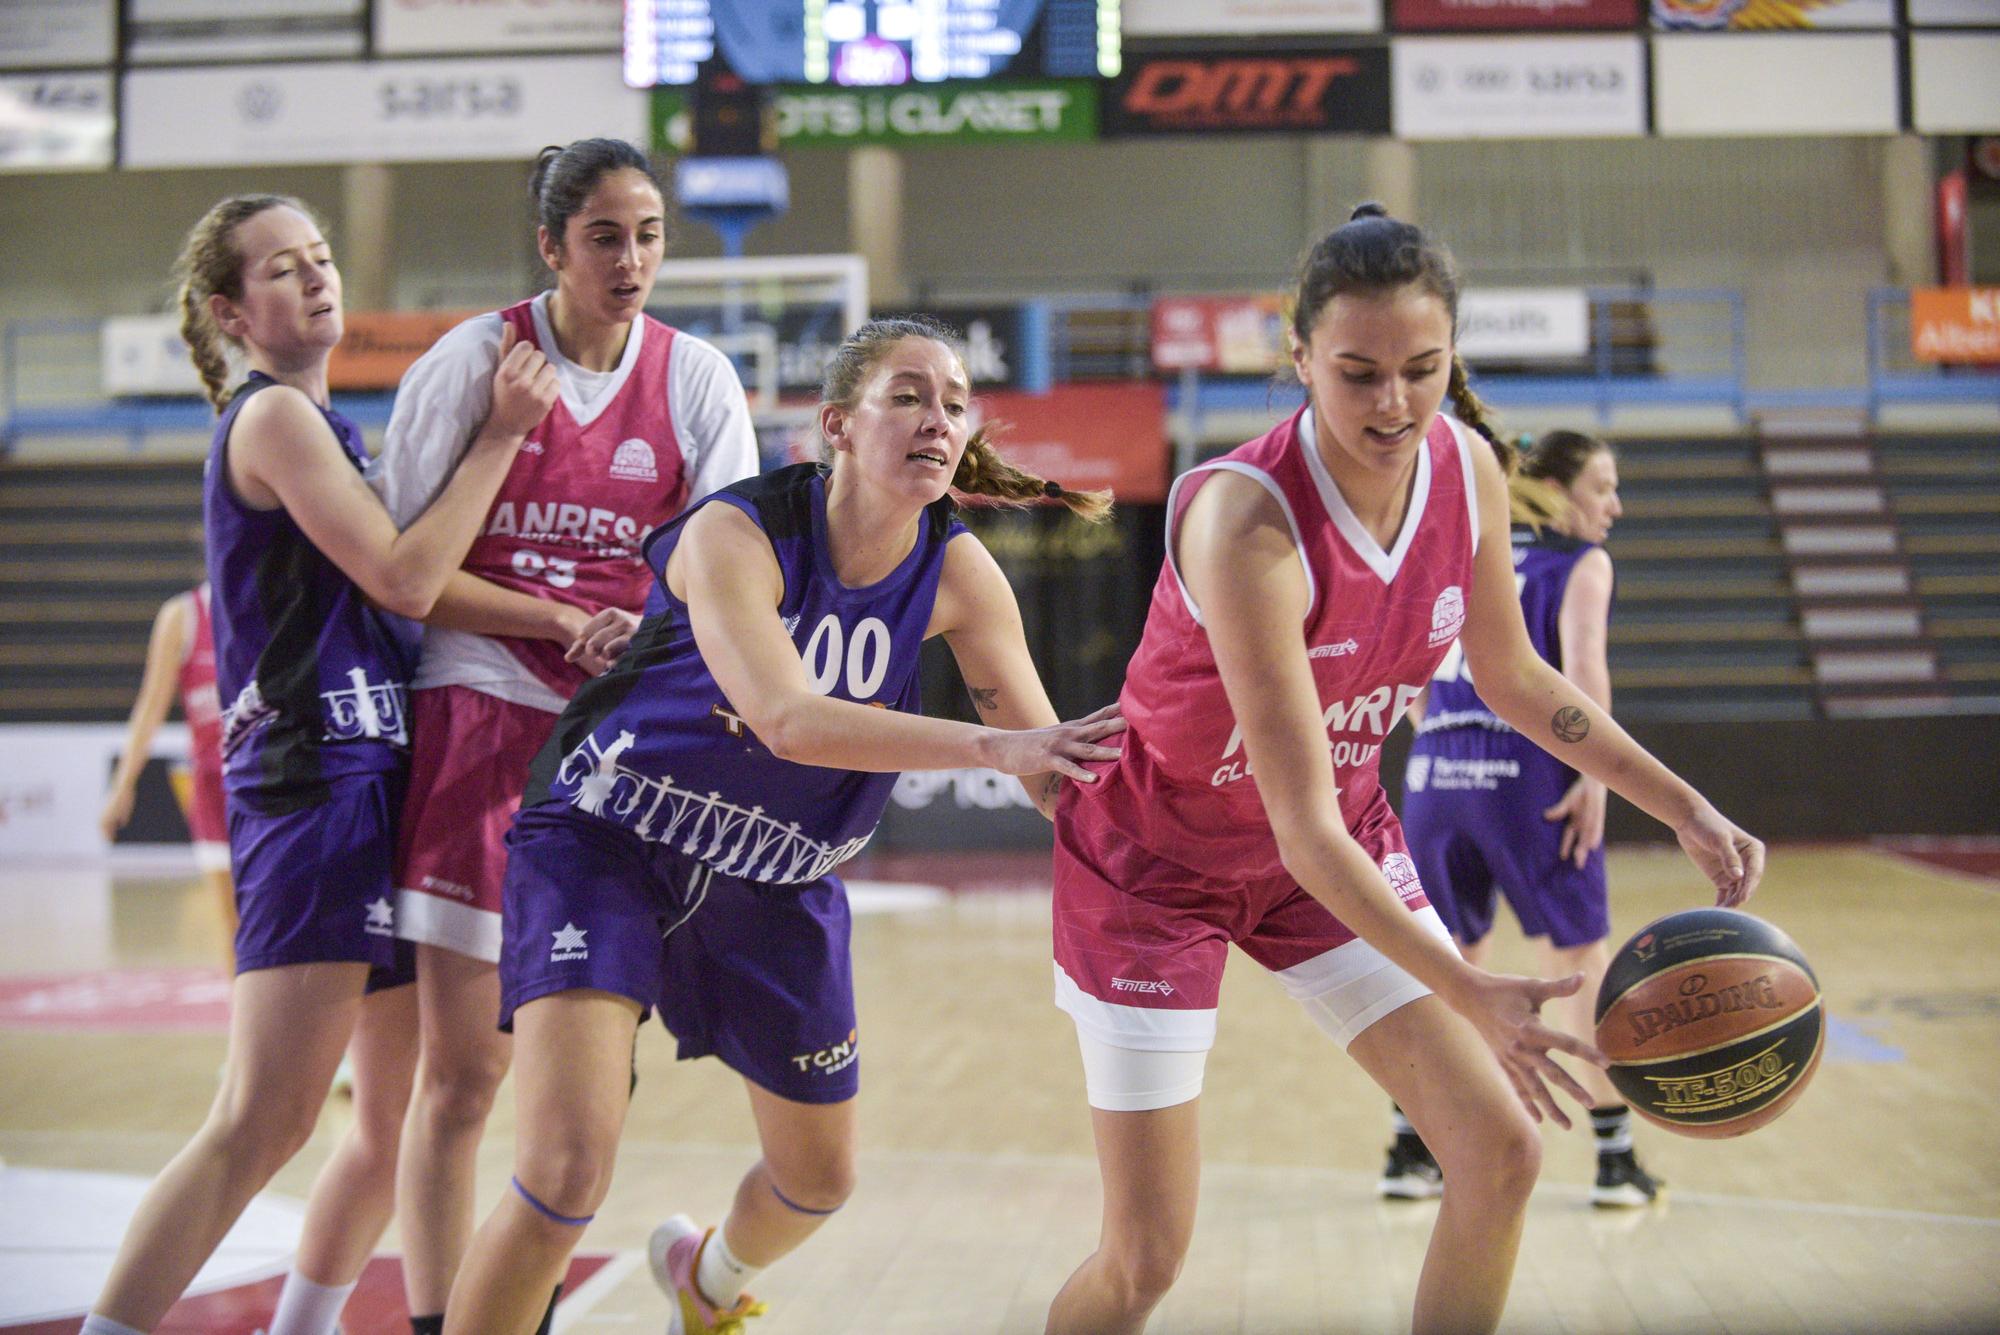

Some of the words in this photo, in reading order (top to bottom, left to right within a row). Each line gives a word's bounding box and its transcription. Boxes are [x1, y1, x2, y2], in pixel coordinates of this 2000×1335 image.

[511, 548, 579, 588] 03
[801, 613, 891, 699] 00
[1111, 977, 1157, 993] PENTEX
[1628, 974, 1782, 1047] SPALDING
[1657, 1052, 1783, 1104] TF-500
